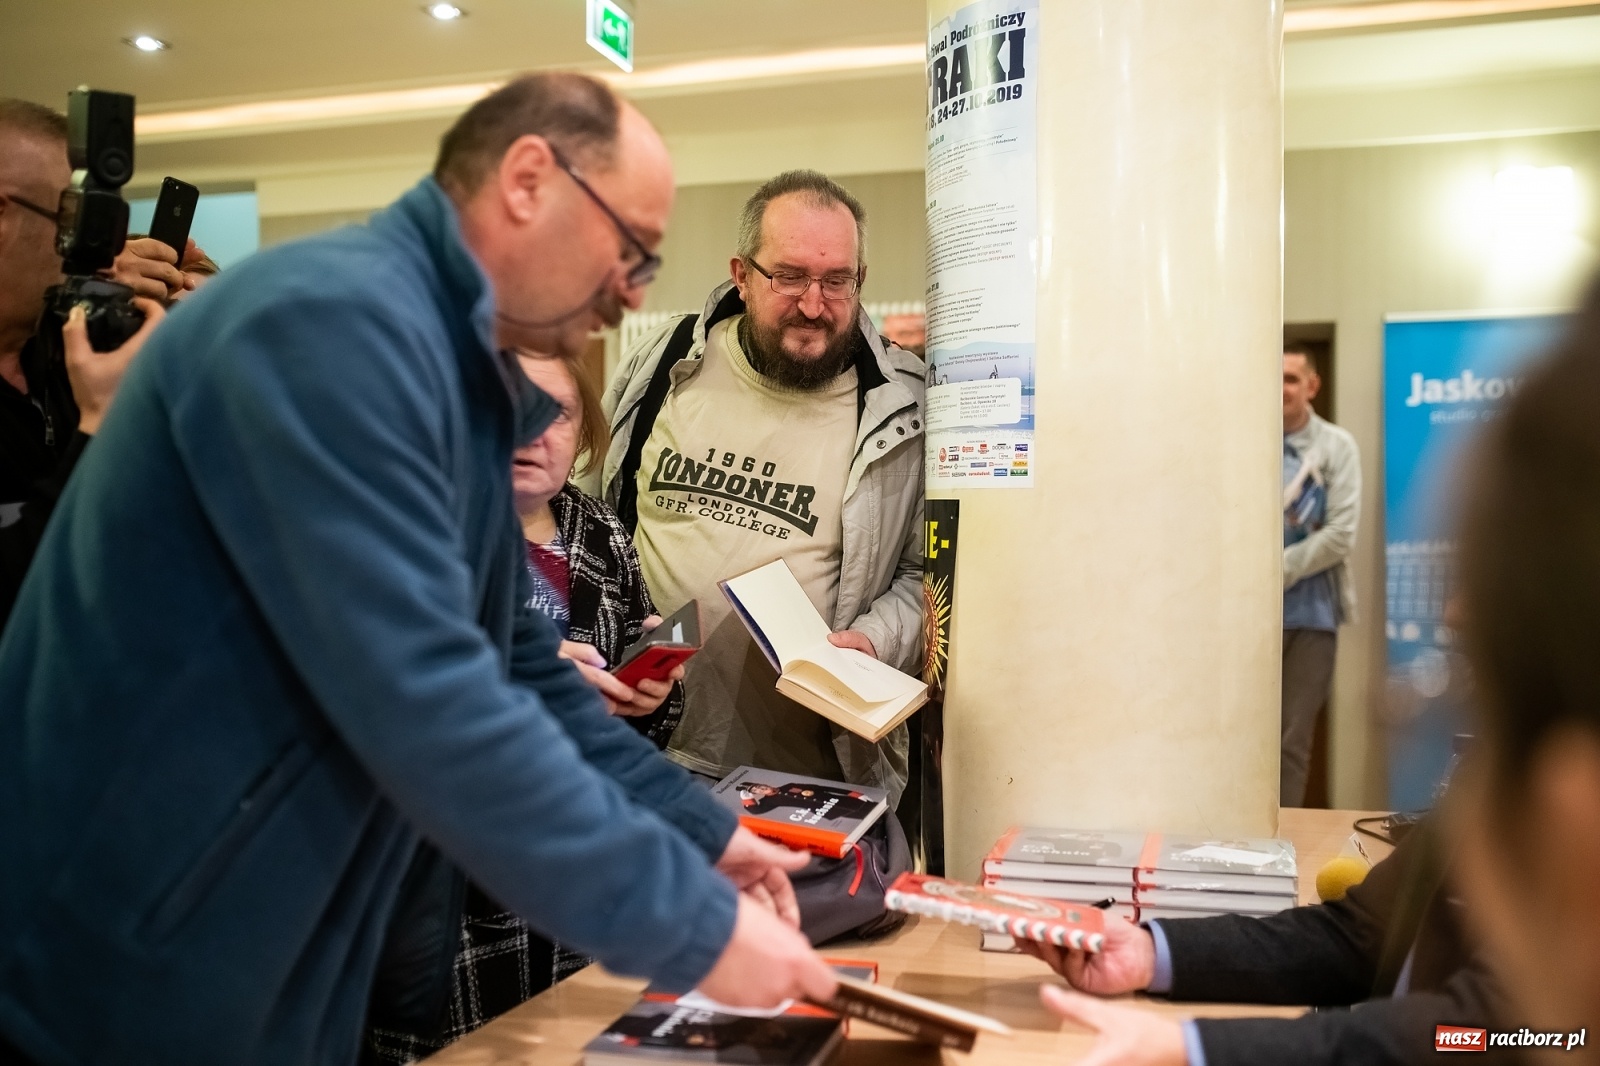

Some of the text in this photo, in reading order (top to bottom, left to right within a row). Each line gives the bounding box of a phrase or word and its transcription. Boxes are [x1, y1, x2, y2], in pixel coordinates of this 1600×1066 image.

[950, 11, 1026, 46] Podróżniczy
[705, 448, 777, 478] 1960
[649, 447, 817, 524] LONDONER
[655, 495, 791, 540] GFR. COLLEGE
[688, 494, 759, 518] LONDON
